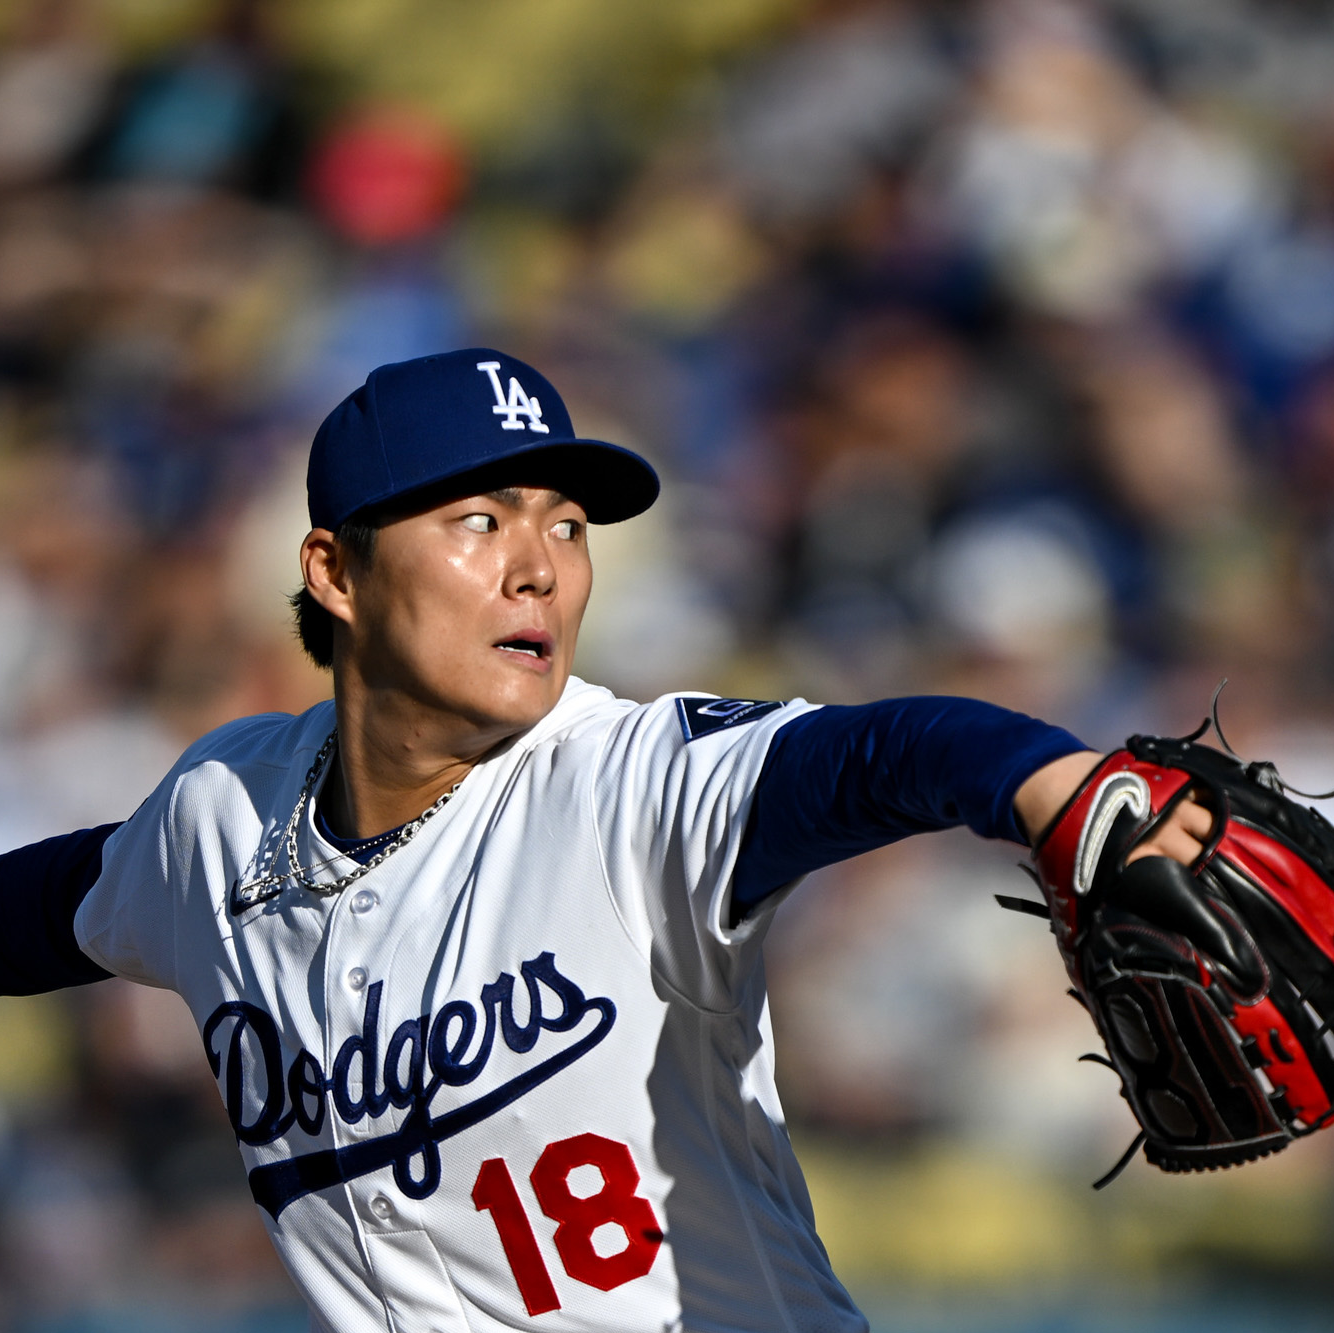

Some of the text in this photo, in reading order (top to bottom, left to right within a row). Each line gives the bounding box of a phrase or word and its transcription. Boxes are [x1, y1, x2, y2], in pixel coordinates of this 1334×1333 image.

[476, 361, 550, 434] LA
[203, 951, 616, 1200] Dodgers
[472, 1132, 665, 1317] 18
